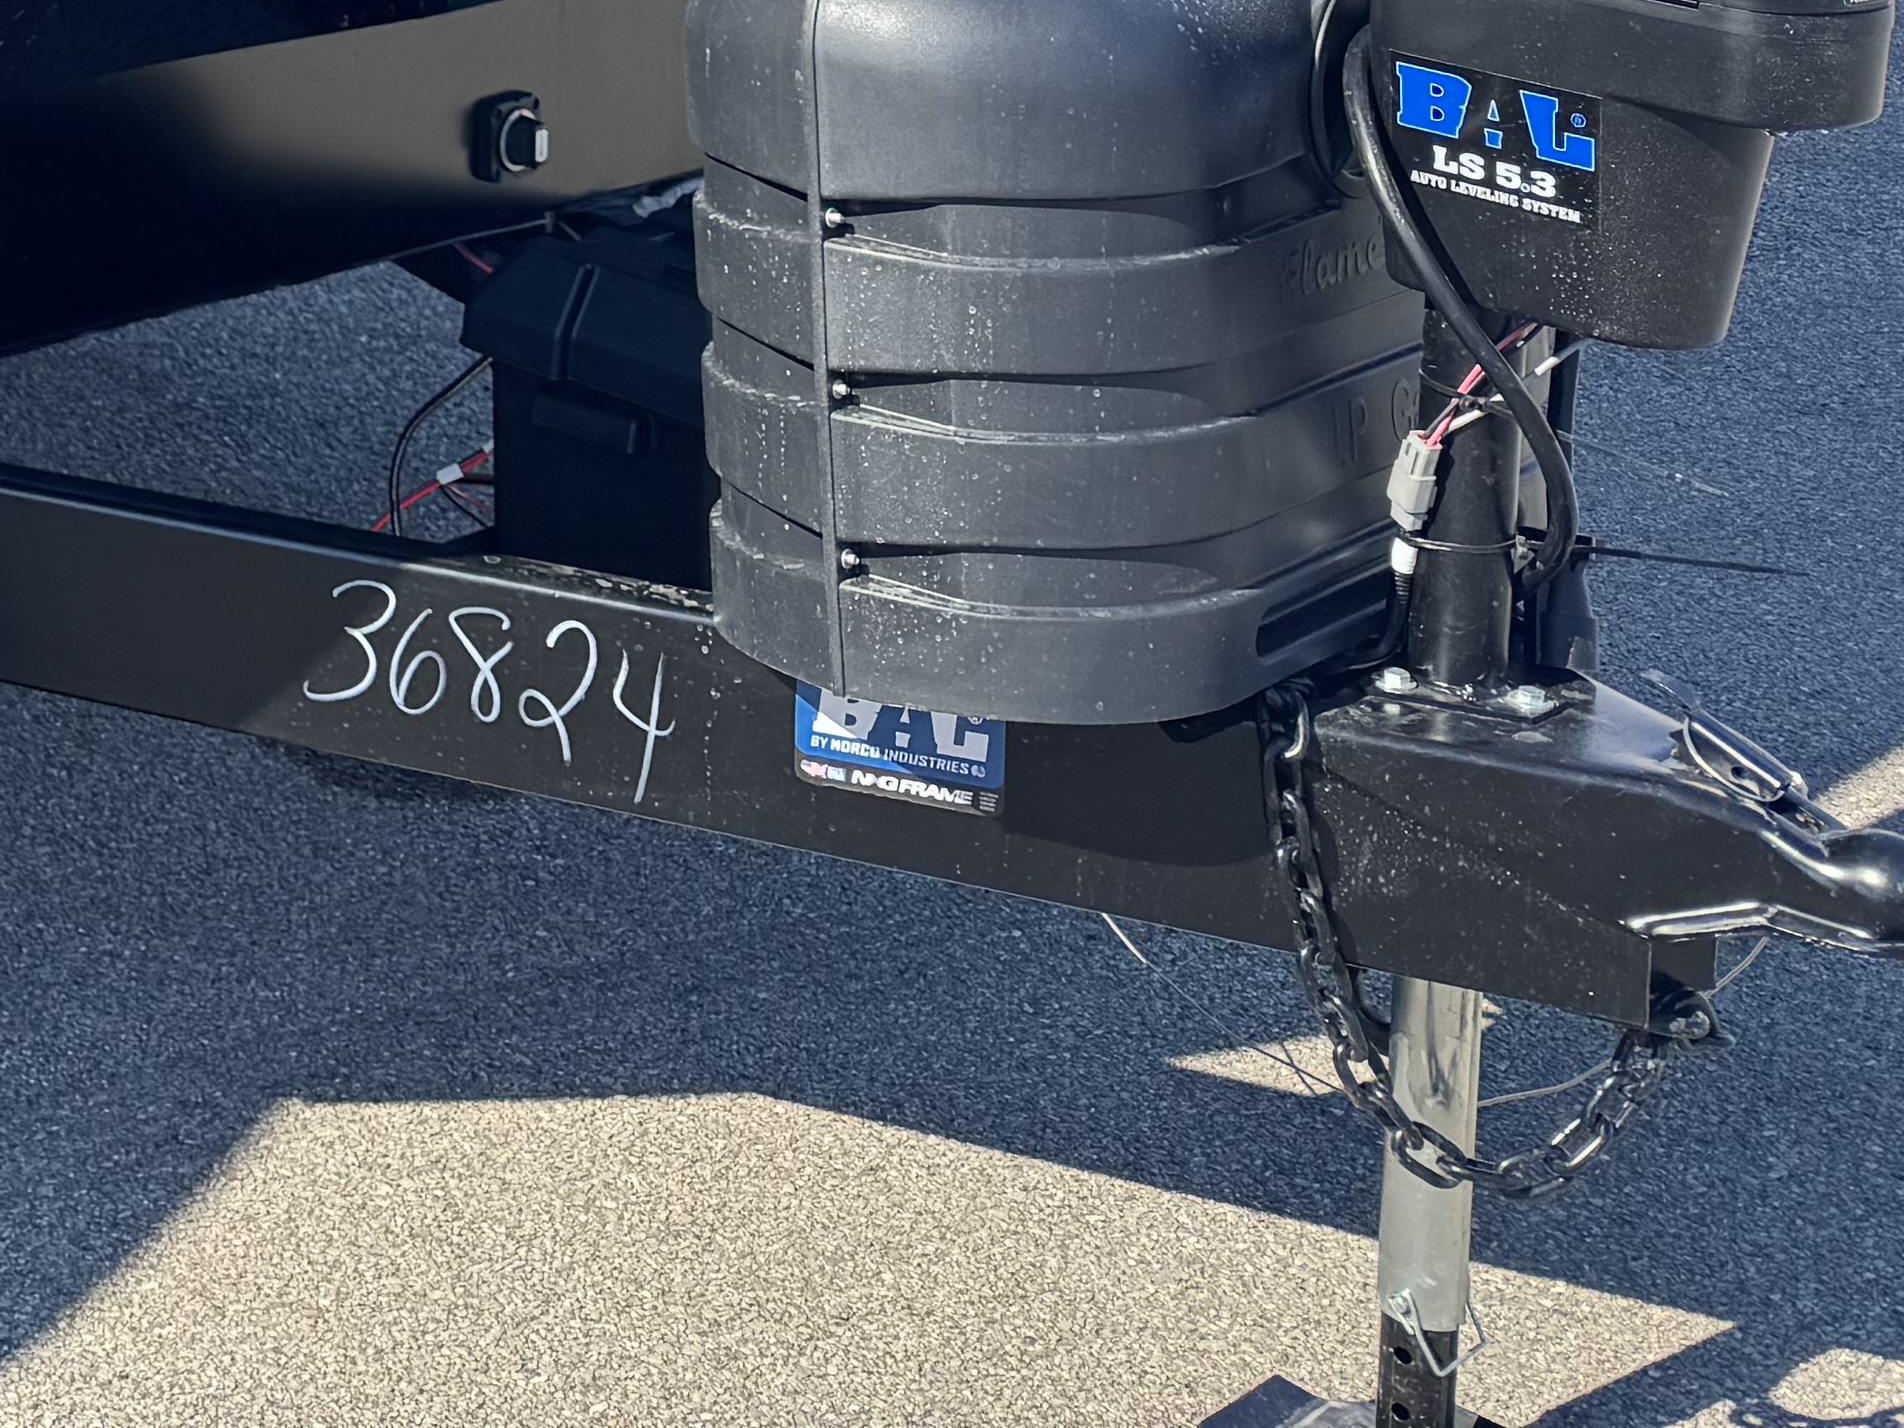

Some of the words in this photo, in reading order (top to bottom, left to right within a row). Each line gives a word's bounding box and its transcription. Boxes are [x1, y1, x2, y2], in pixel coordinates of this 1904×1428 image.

[1396, 61, 1595, 172] BAL
[1409, 169, 1447, 190] AUTO
[1450, 179, 1519, 208] LEVELING
[1521, 197, 1582, 224] SYSTEM
[1432, 144, 1485, 180] LS
[1495, 161, 1557, 198] 5.3
[303, 579, 676, 803] 36824
[810, 735, 829, 748] BY
[883, 748, 970, 775] INDUSTRIES
[811, 687, 990, 762] BAL
